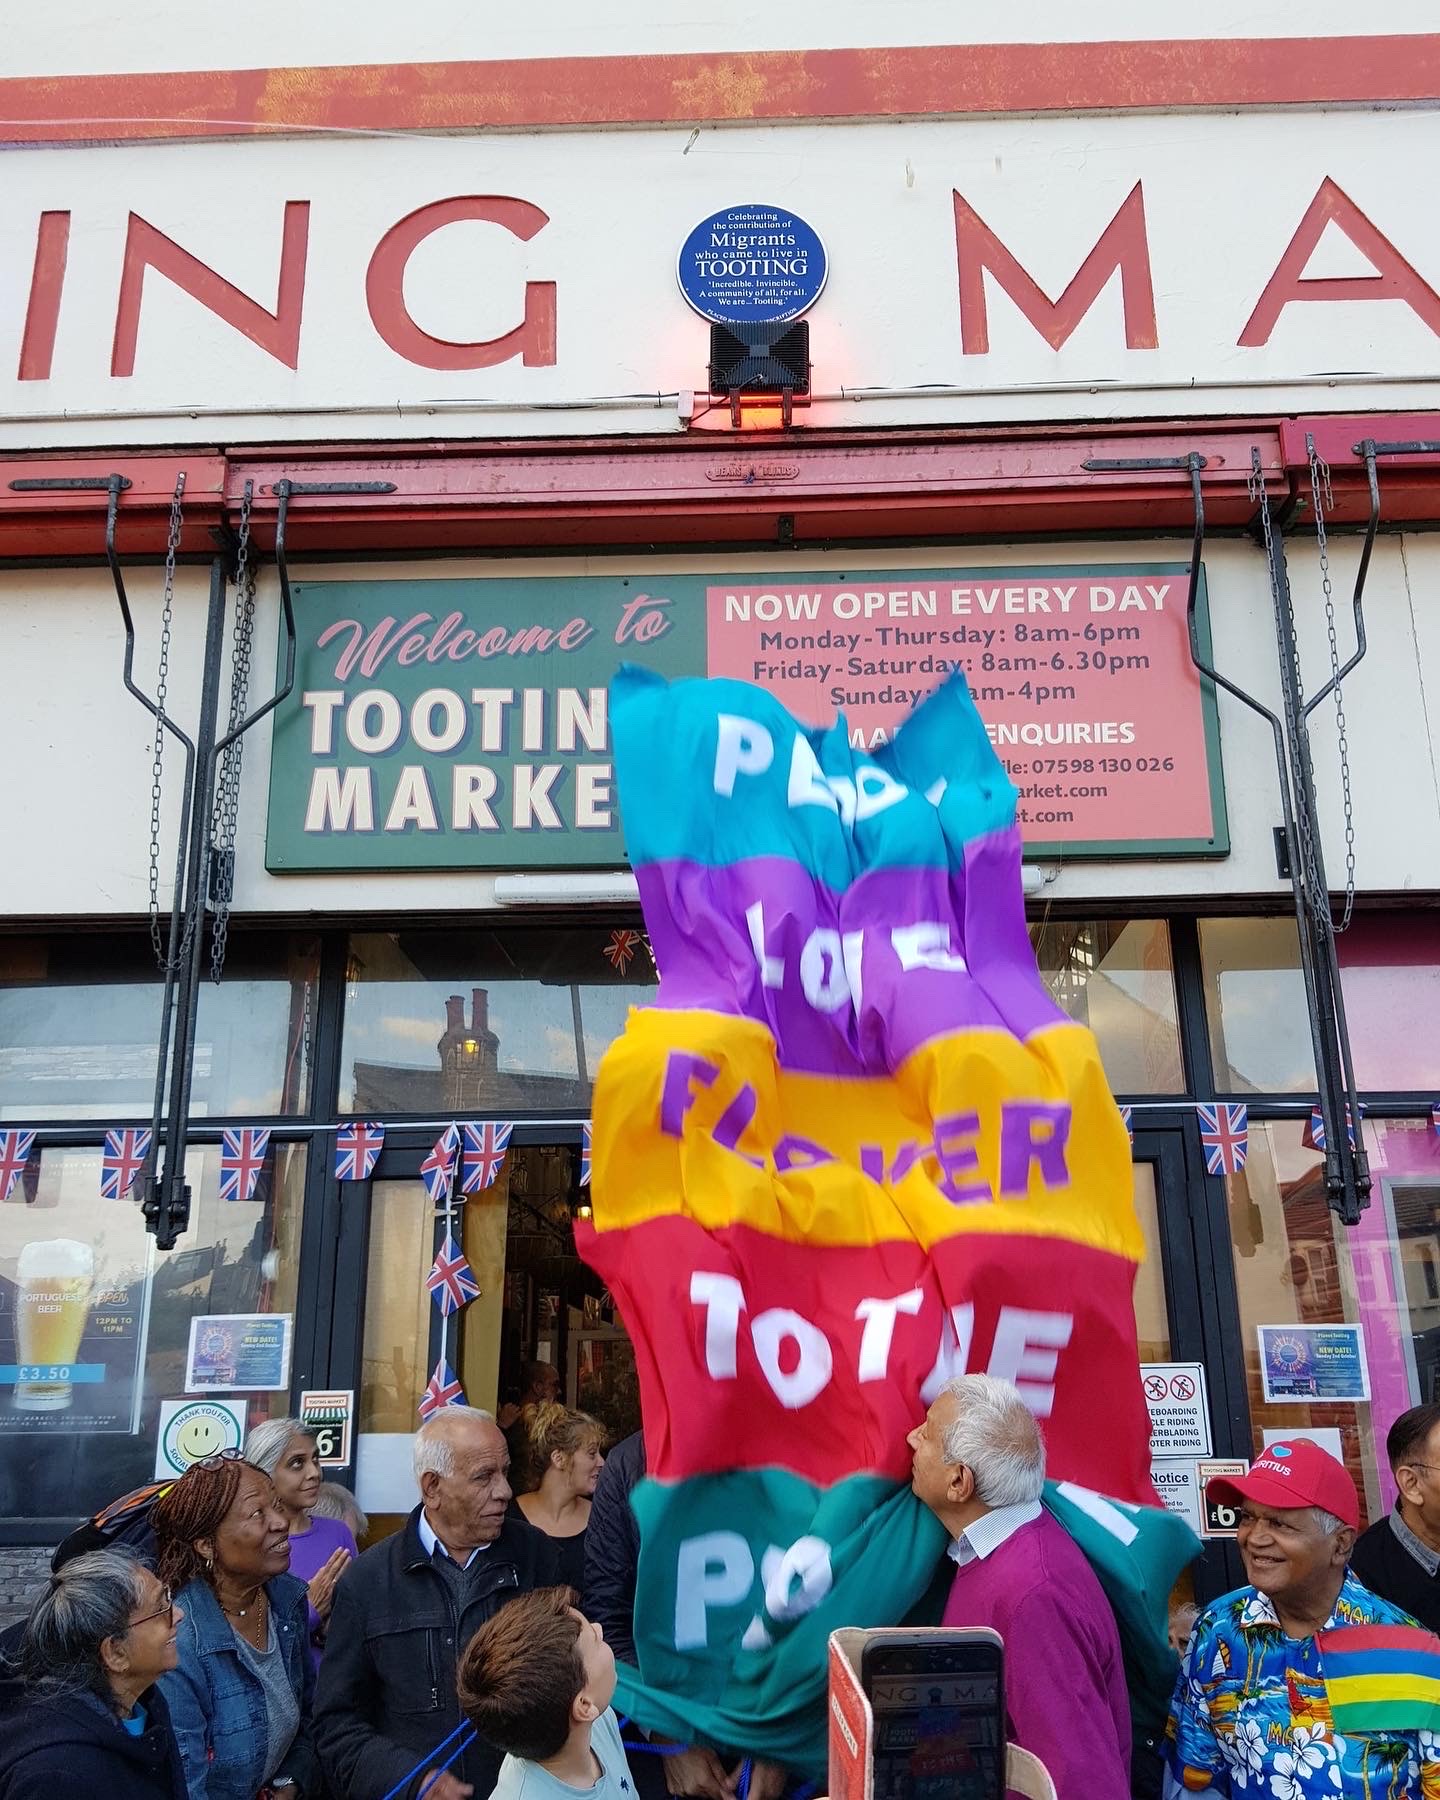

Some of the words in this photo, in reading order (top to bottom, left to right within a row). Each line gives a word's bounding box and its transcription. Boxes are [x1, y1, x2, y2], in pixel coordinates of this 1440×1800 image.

[727, 212, 778, 222] Celebrating
[713, 222, 726, 230] the
[728, 221, 781, 230] contribution
[782, 220, 792, 228] of
[710, 232, 796, 250] Migrants
[695, 250, 719, 260] who
[722, 251, 753, 259] came
[757, 250, 768, 258] to
[771, 248, 793, 258] live
[797, 247, 808, 257] in
[695, 258, 808, 277] TOOTING
[18, 194, 557, 382] ING
[953, 175, 1440, 355] MA
[756, 279, 798, 287] Invincible.
[699, 290, 706, 298] A
[707, 289, 753, 298] community
[755, 288, 765, 296] of
[765, 289, 779, 297] all,
[780, 288, 792, 296] for
[793, 288, 807, 296] all.
[718, 298, 731, 306] We
[707, 308, 728, 322] PLACED
[725, 593, 822, 622] NOW
[832, 591, 938, 619] OPEN
[951, 586, 1077, 615] EVERY
[1089, 584, 1171, 612] DAY
[316, 611, 594, 682] Welcome
[613, 594, 676, 645] to
[1014, 622, 1140, 646] 8am-6pm
[981, 650, 1150, 675] 8am-6.30pm
[1032, 758, 1095, 774] 07598
[1098, 758, 1132, 772] 130
[1135, 757, 1175, 772] 026
[20, 1293, 82, 1303] PORTUGUESE
[37, 1304, 63, 1313] BEER
[96, 1317, 118, 1325] 12PM
[103, 1325, 123, 1333] 11PM
[1318, 1346, 1334, 1354] NEW
[1334, 1346, 1352, 1354] DATE!
[18, 1367, 70, 1380] £3.50
[174, 1408, 200, 1427] THANK
[201, 1407, 217, 1418] YOU
[217, 1412, 231, 1426] FOR
[1167, 1417, 1196, 1426] RIDING
[1173, 1438, 1202, 1447] RIDING
[1150, 1472, 1189, 1484] Notice
